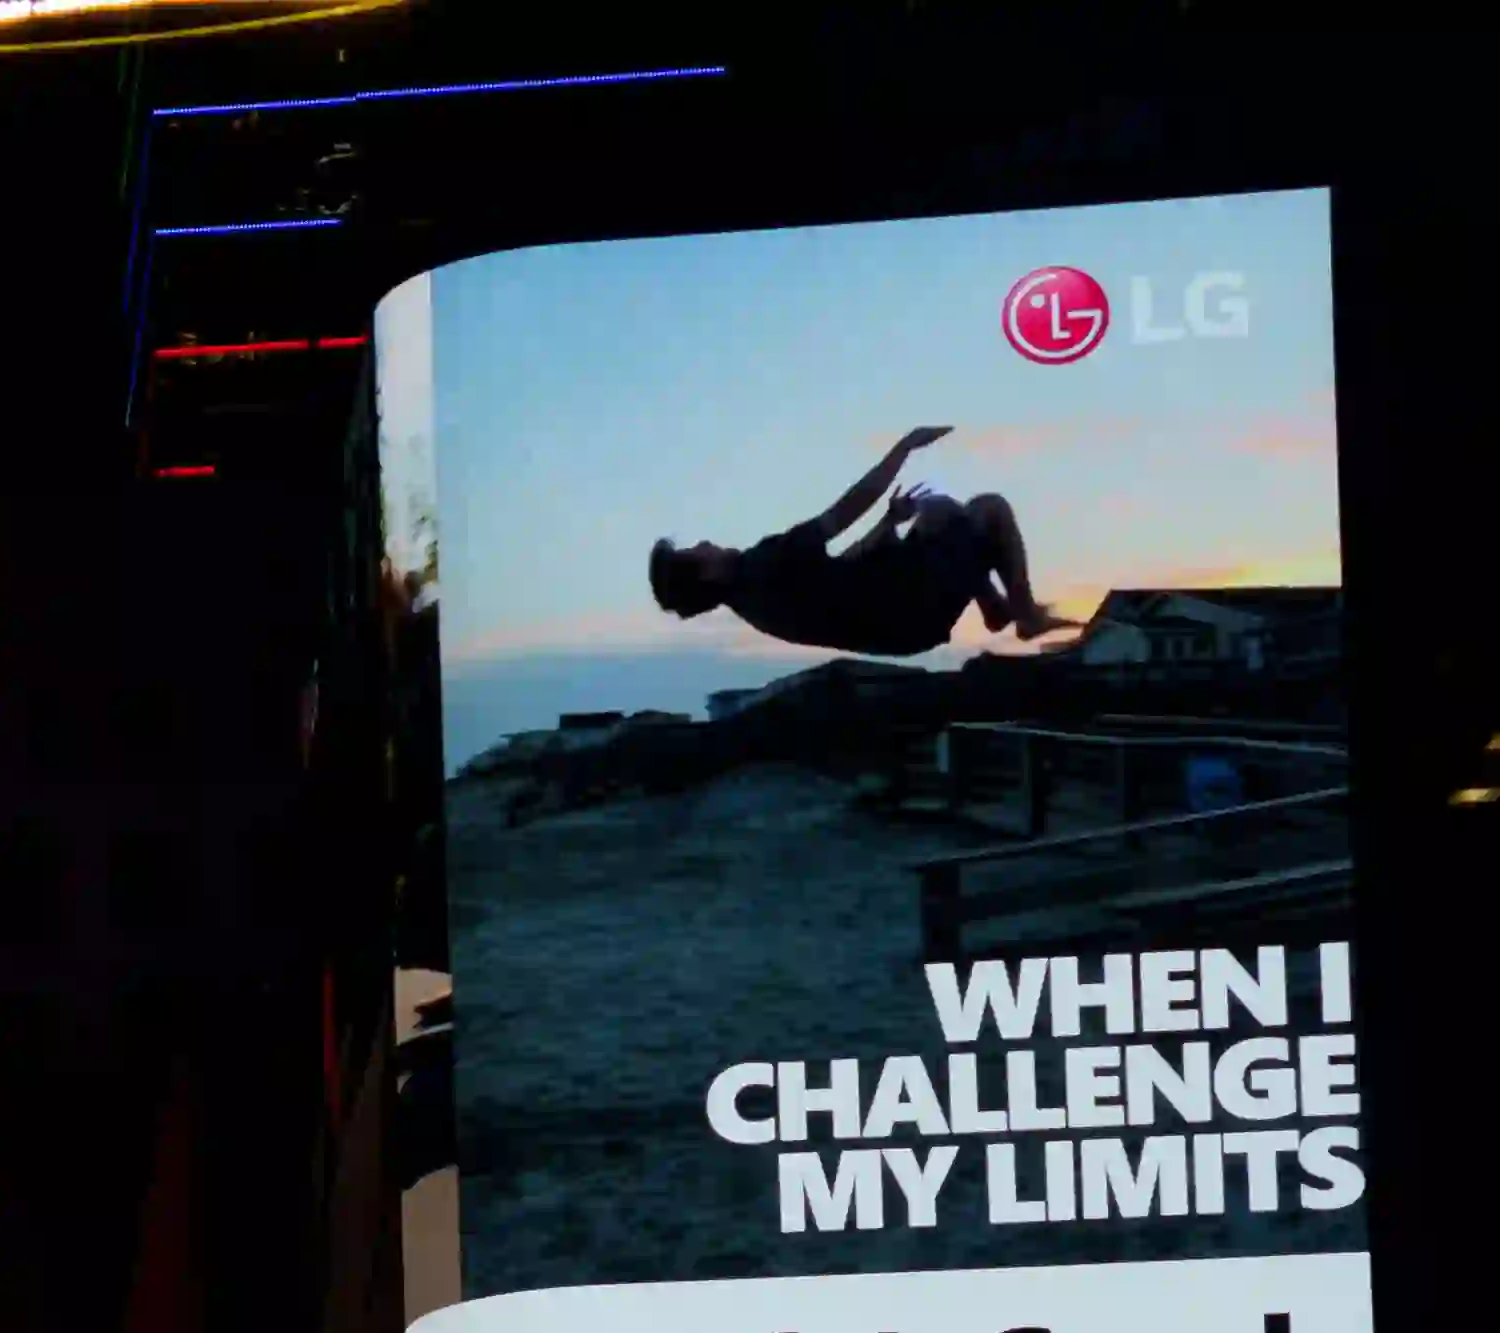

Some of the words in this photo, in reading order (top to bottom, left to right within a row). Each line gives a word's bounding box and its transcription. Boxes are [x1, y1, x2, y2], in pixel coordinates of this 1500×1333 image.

[1131, 271, 1251, 342] LG
[925, 944, 1287, 1042] WHEN
[1319, 941, 1355, 1026] I
[705, 1033, 1362, 1145] CHALLENGE
[778, 1142, 955, 1234] MY
[986, 1126, 1367, 1226] LIMITS
